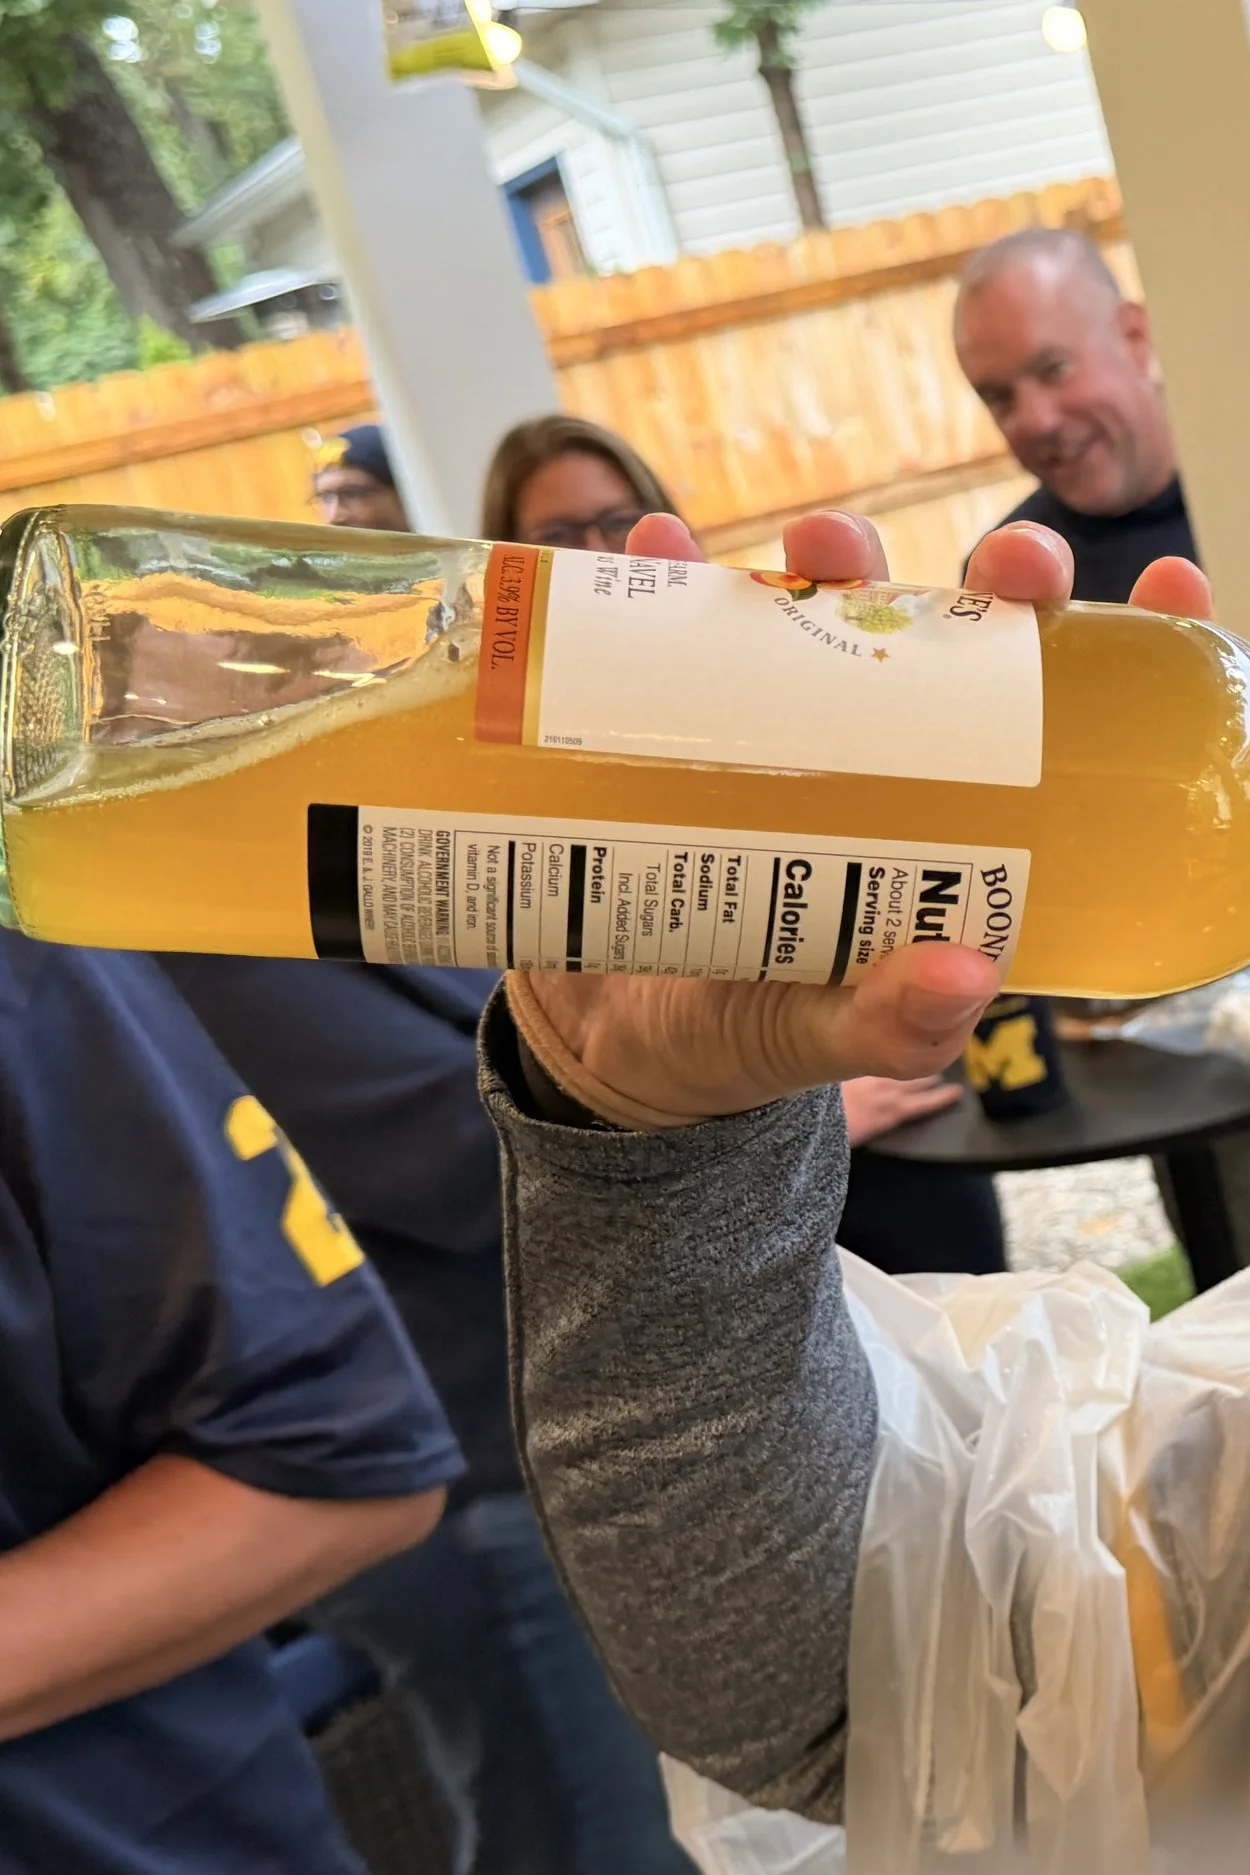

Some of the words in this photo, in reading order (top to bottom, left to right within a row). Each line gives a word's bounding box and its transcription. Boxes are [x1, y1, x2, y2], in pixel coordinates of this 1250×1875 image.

[594, 567, 620, 596] Wine
[495, 606, 519, 628] BY
[773, 597, 863, 657] ORIGINAL
[491, 630, 517, 670] VOL.
[400, 827, 415, 839] (2)
[418, 829, 433, 857] DRINK
[381, 826, 398, 882] MACHINERY,
[400, 842, 415, 901] CONSUMPTION
[435, 830, 451, 897] GOVERNMENT
[466, 843, 479, 880] vitamin
[486, 845, 501, 864] Not
[548, 843, 565, 897] Calcium
[672, 852, 688, 893] Total
[418, 860, 433, 905] ALCOHOLIC
[465, 882, 479, 893] D,
[520, 842, 537, 909] Potassium
[590, 846, 607, 904] Protein
[618, 872, 633, 897] Incl.
[645, 863, 660, 896] Total
[697, 853, 715, 911] Sodium
[725, 855, 742, 896] Total
[887, 867, 909, 914] About
[363, 884, 374, 907] GALLO
[382, 884, 397, 904] AND
[383, 904, 398, 921] MAY
[400, 903, 415, 913] OF
[466, 896, 479, 912] and
[483, 876, 500, 921] significant
[722, 901, 738, 924] Fat
[775, 859, 813, 964] Calories
[858, 866, 886, 935] Serving
[912, 869, 962, 944] Nut
[978, 863, 1013, 962] BOON
[616, 898, 632, 932] Added
[640, 899, 659, 937] Sugars
[669, 898, 685, 933] Carb.
[886, 918, 902, 927] 2
[612, 934, 630, 960] Sugars
[856, 940, 875, 964] size
